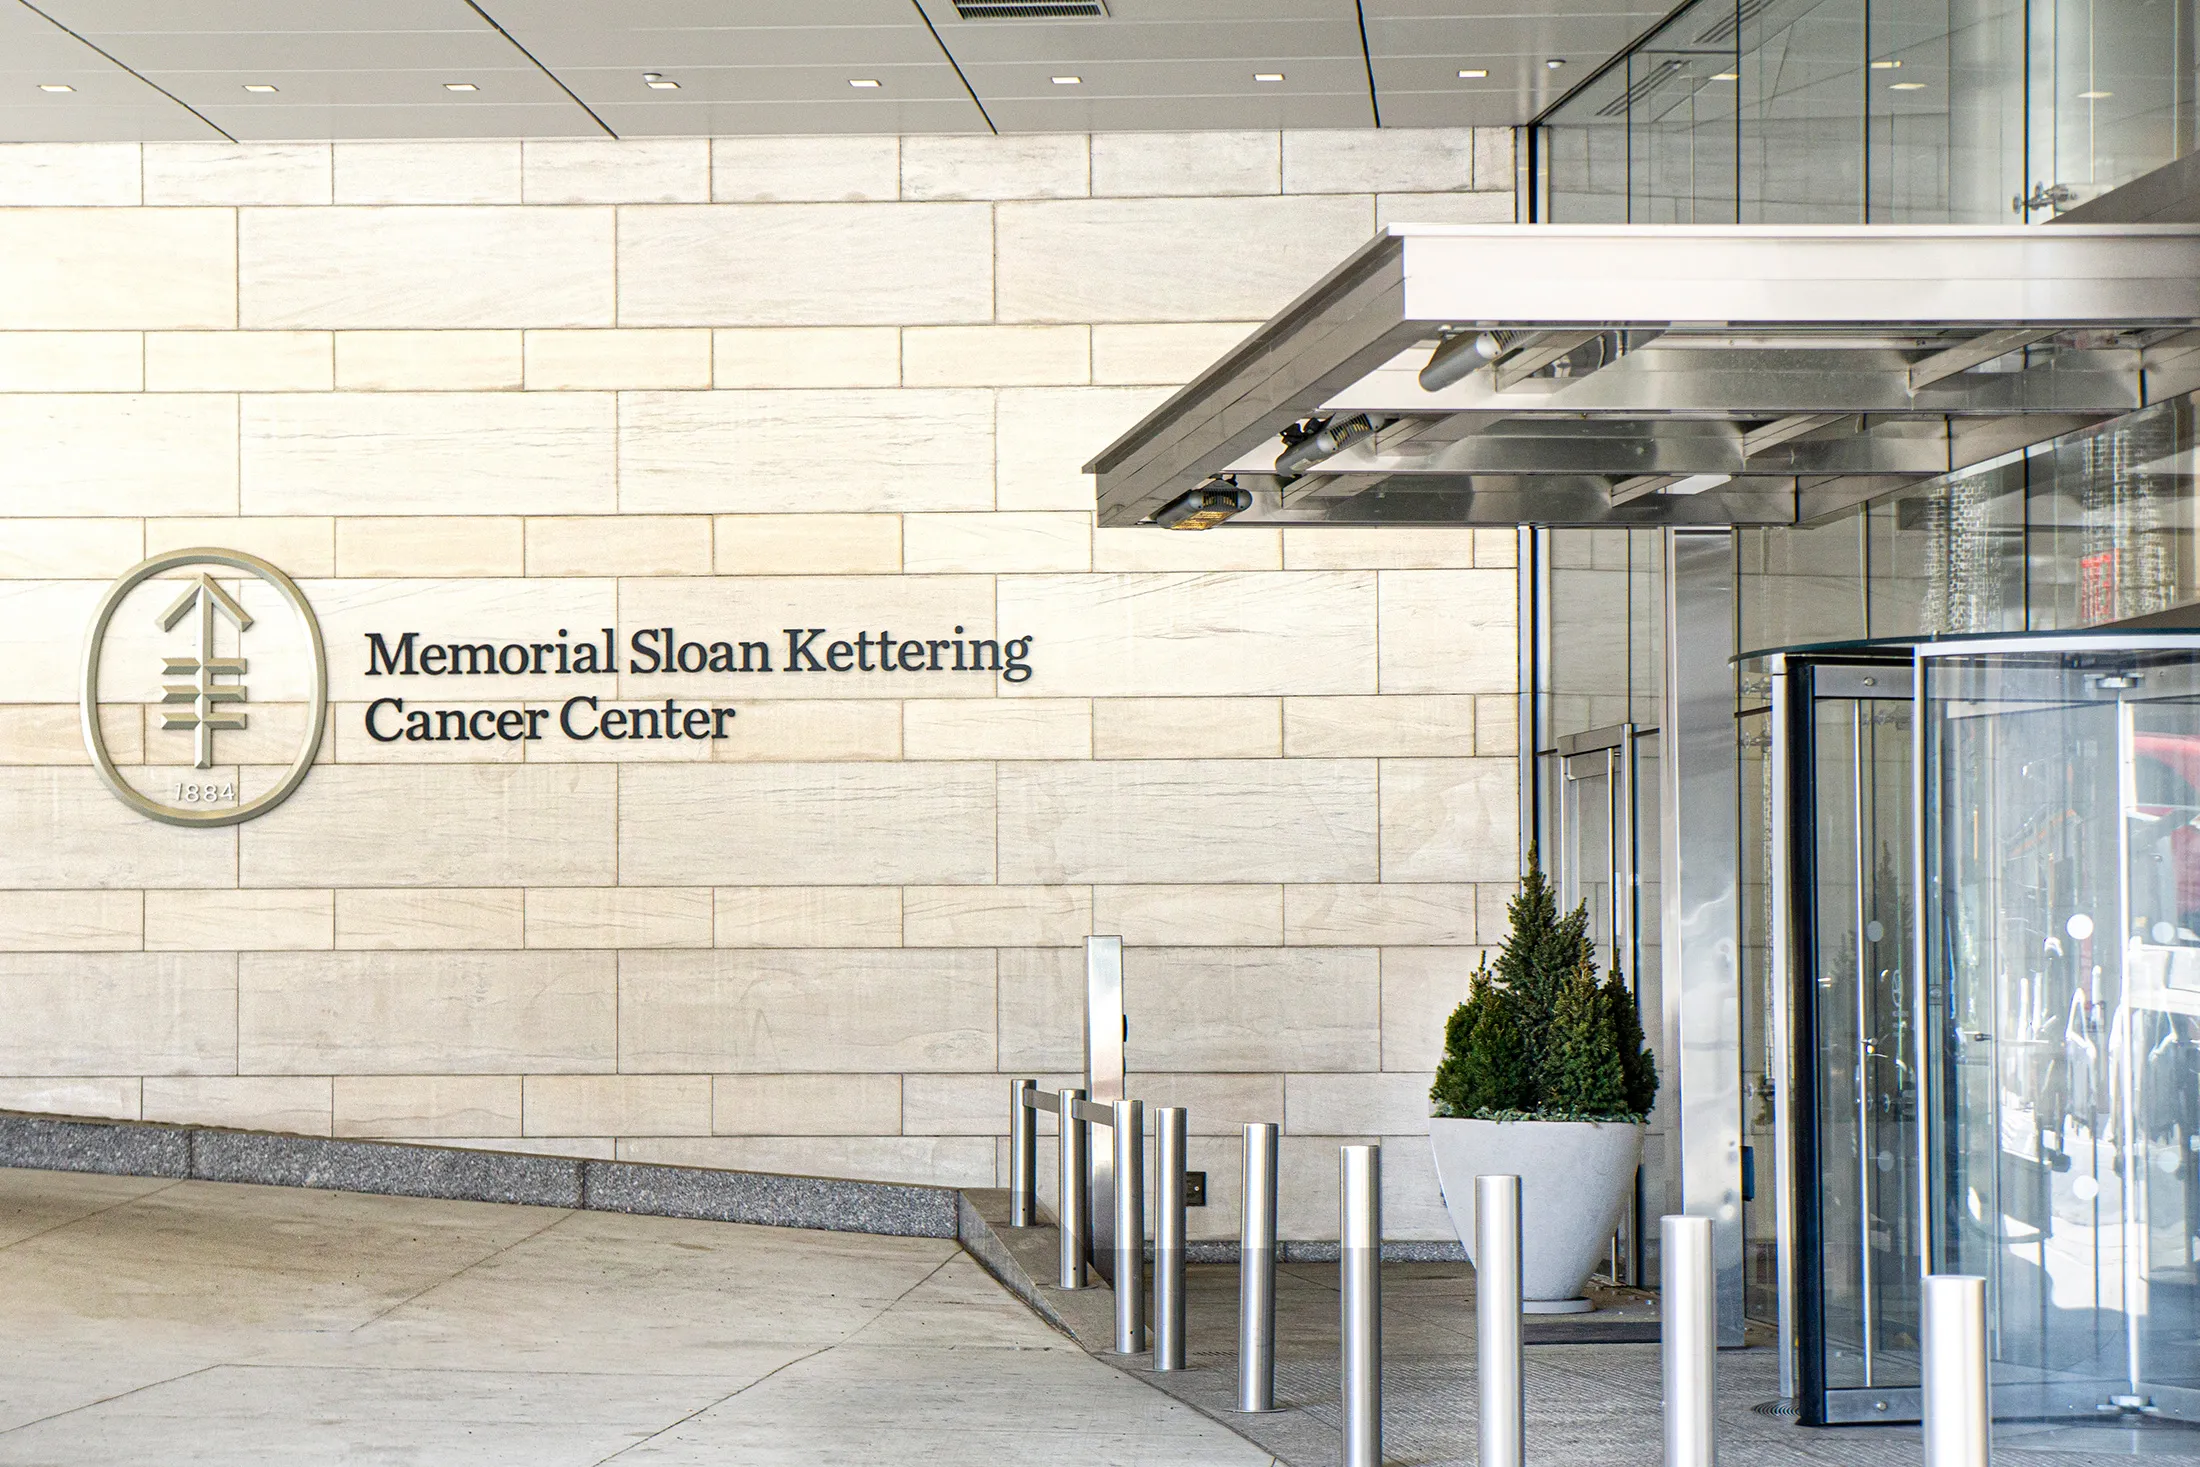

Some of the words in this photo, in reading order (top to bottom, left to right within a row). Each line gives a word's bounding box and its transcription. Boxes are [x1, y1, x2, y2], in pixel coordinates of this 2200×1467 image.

[364, 628, 619, 676] Memorial
[630, 628, 773, 675] Sloan
[783, 625, 1034, 683] Kettering
[365, 696, 550, 743] Cancer
[560, 695, 736, 741] Center
[175, 782, 236, 803] 1884
